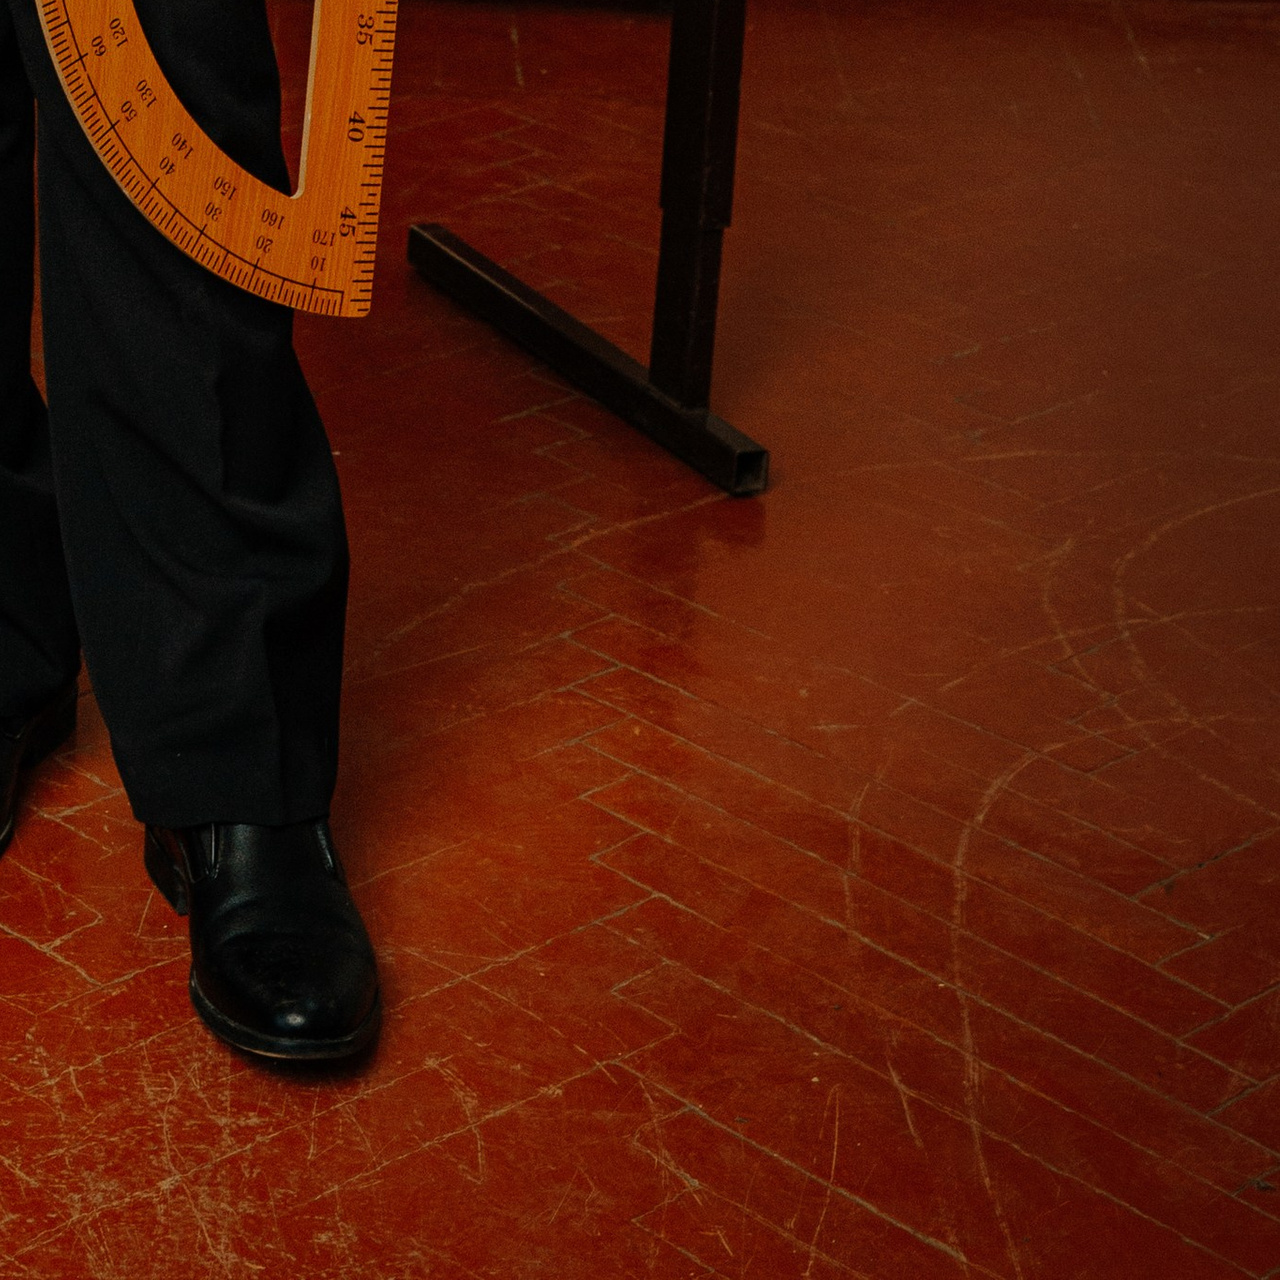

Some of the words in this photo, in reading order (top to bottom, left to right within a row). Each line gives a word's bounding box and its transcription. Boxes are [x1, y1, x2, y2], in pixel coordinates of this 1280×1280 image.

[109, 18, 129, 47] 120
[356, 14, 375, 46] 35
[91, 35, 107, 57] 60
[136, 79, 157, 108] 130
[120, 100, 137, 122] 50
[347, 111, 366, 143] 40
[171, 132, 194, 160] 140
[159, 156, 176, 175] 40
[213, 176, 237, 200] 150
[205, 202, 222, 221] 30
[261, 208, 285, 230] 160
[339, 206, 357, 237] 45
[256, 235, 273, 254] 20
[312, 229, 336, 247] 170
[310, 255, 326, 271] 10
